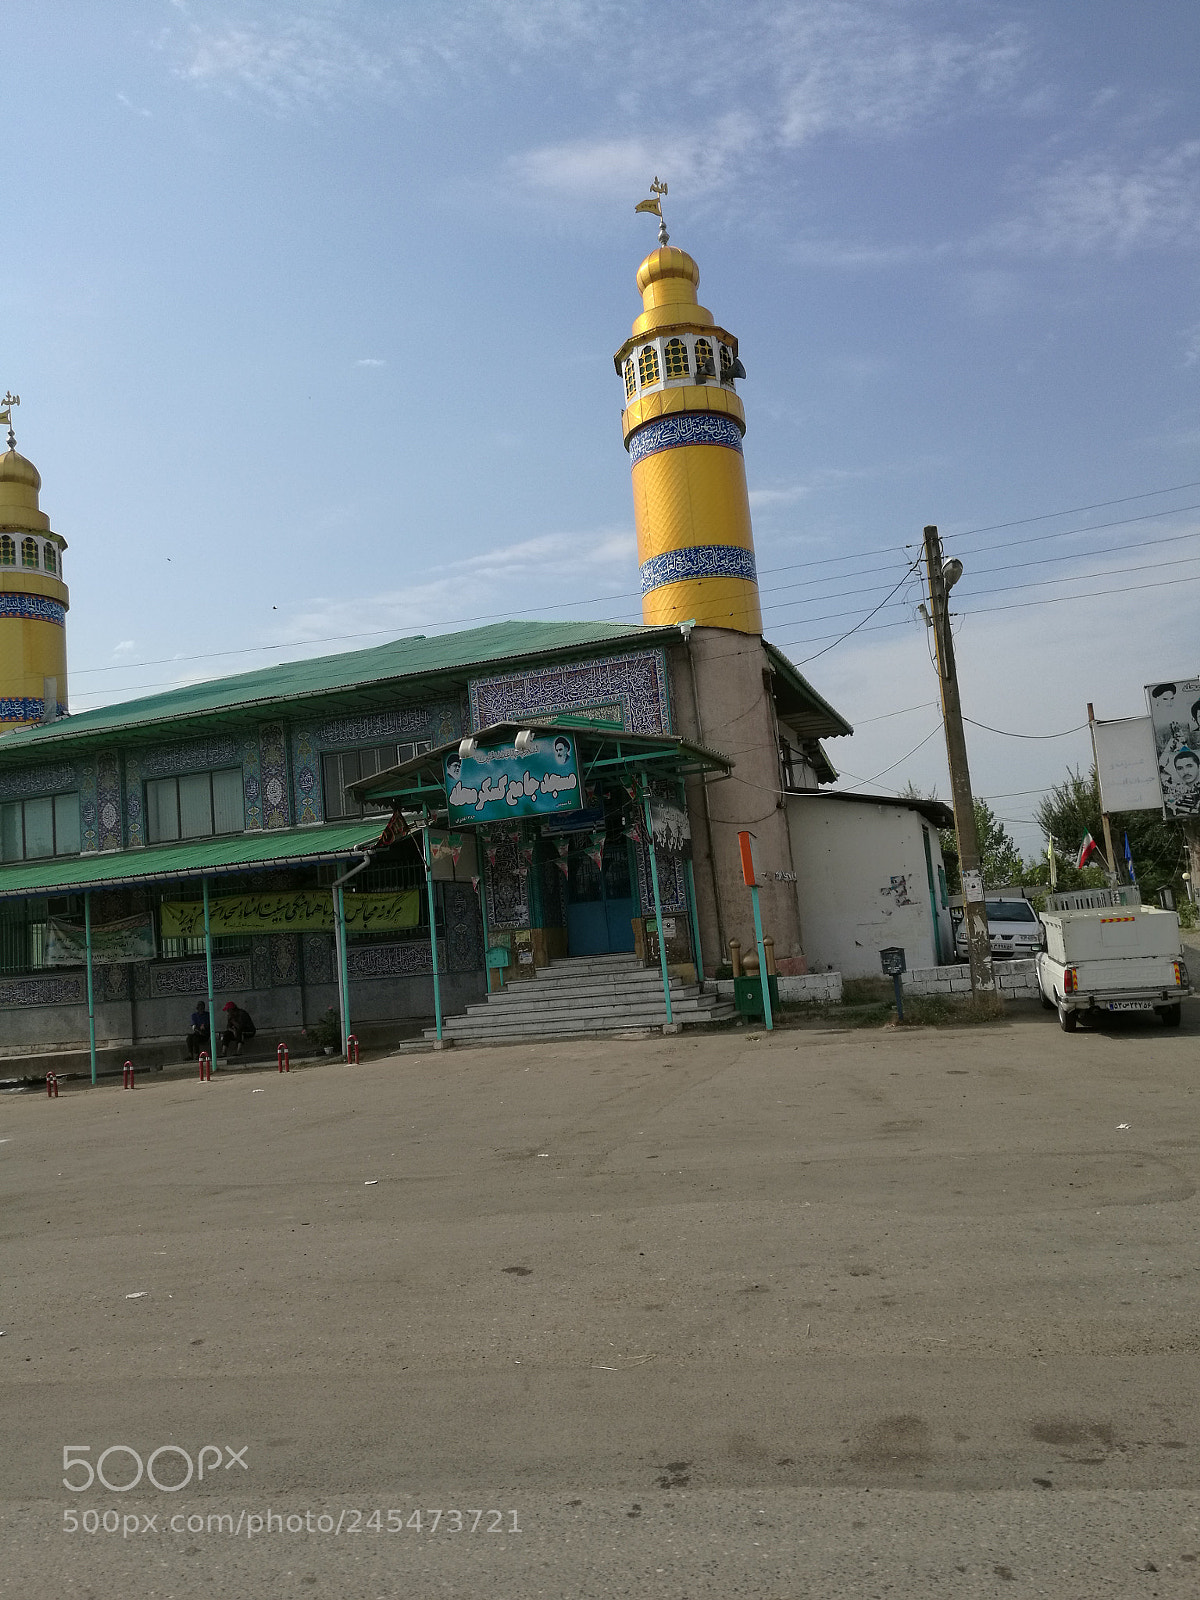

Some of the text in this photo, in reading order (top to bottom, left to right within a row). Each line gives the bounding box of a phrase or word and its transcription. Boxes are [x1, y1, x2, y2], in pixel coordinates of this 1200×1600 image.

[449, 780, 478, 806] محله
[506, 770, 541, 806] جامع
[540, 773, 577, 799] مسجد
